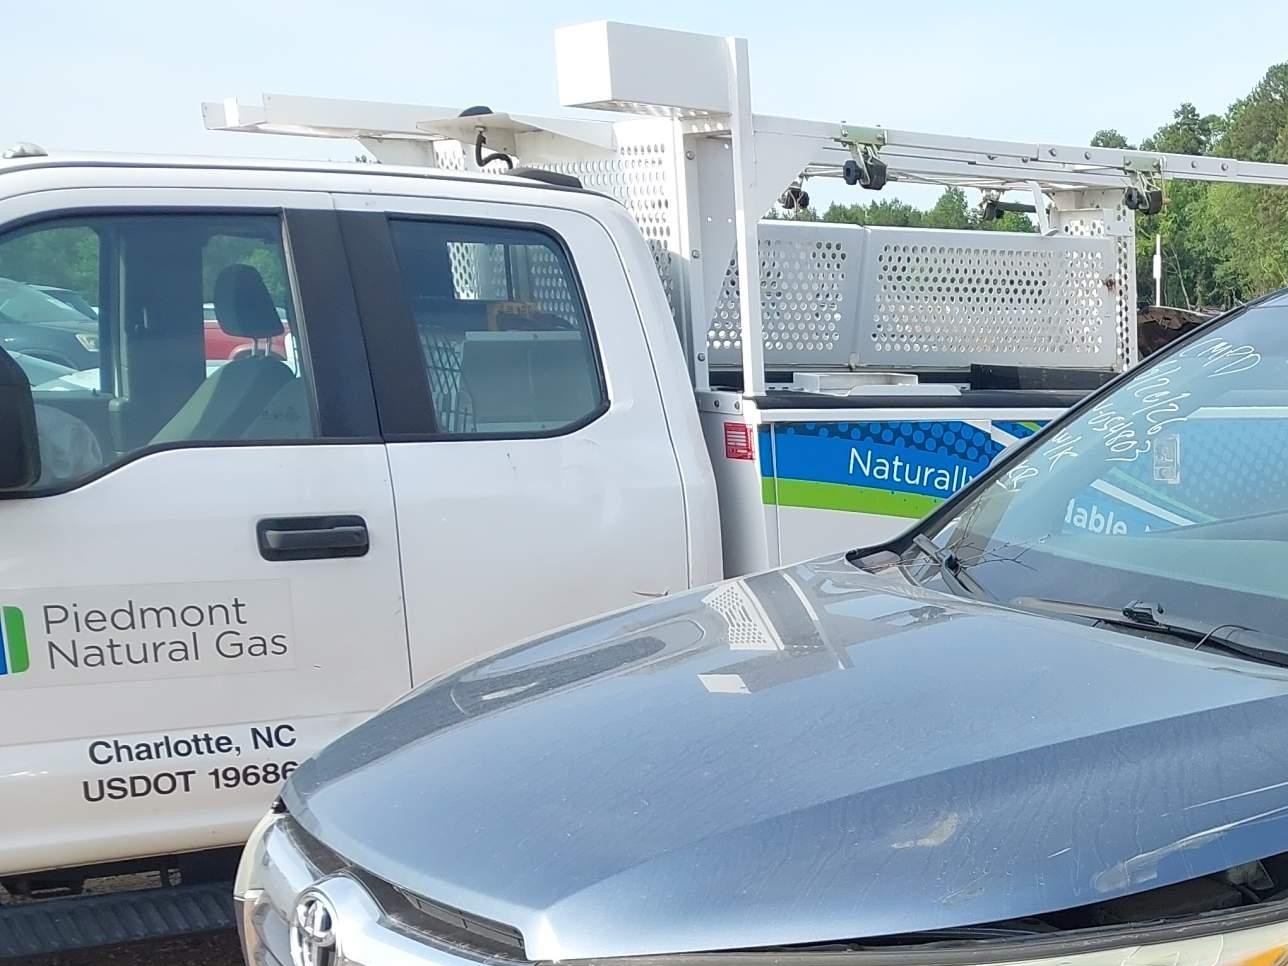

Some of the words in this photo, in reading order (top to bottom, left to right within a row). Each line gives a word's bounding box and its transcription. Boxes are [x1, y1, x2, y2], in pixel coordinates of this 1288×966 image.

[43, 598, 247, 634] Piedmont
[47, 632, 200, 669] Natural
[215, 630, 288, 659] Gas
[88, 733, 241, 765] Charlotte,
[250, 724, 297, 750] NC
[82, 770, 196, 802] USDOT
